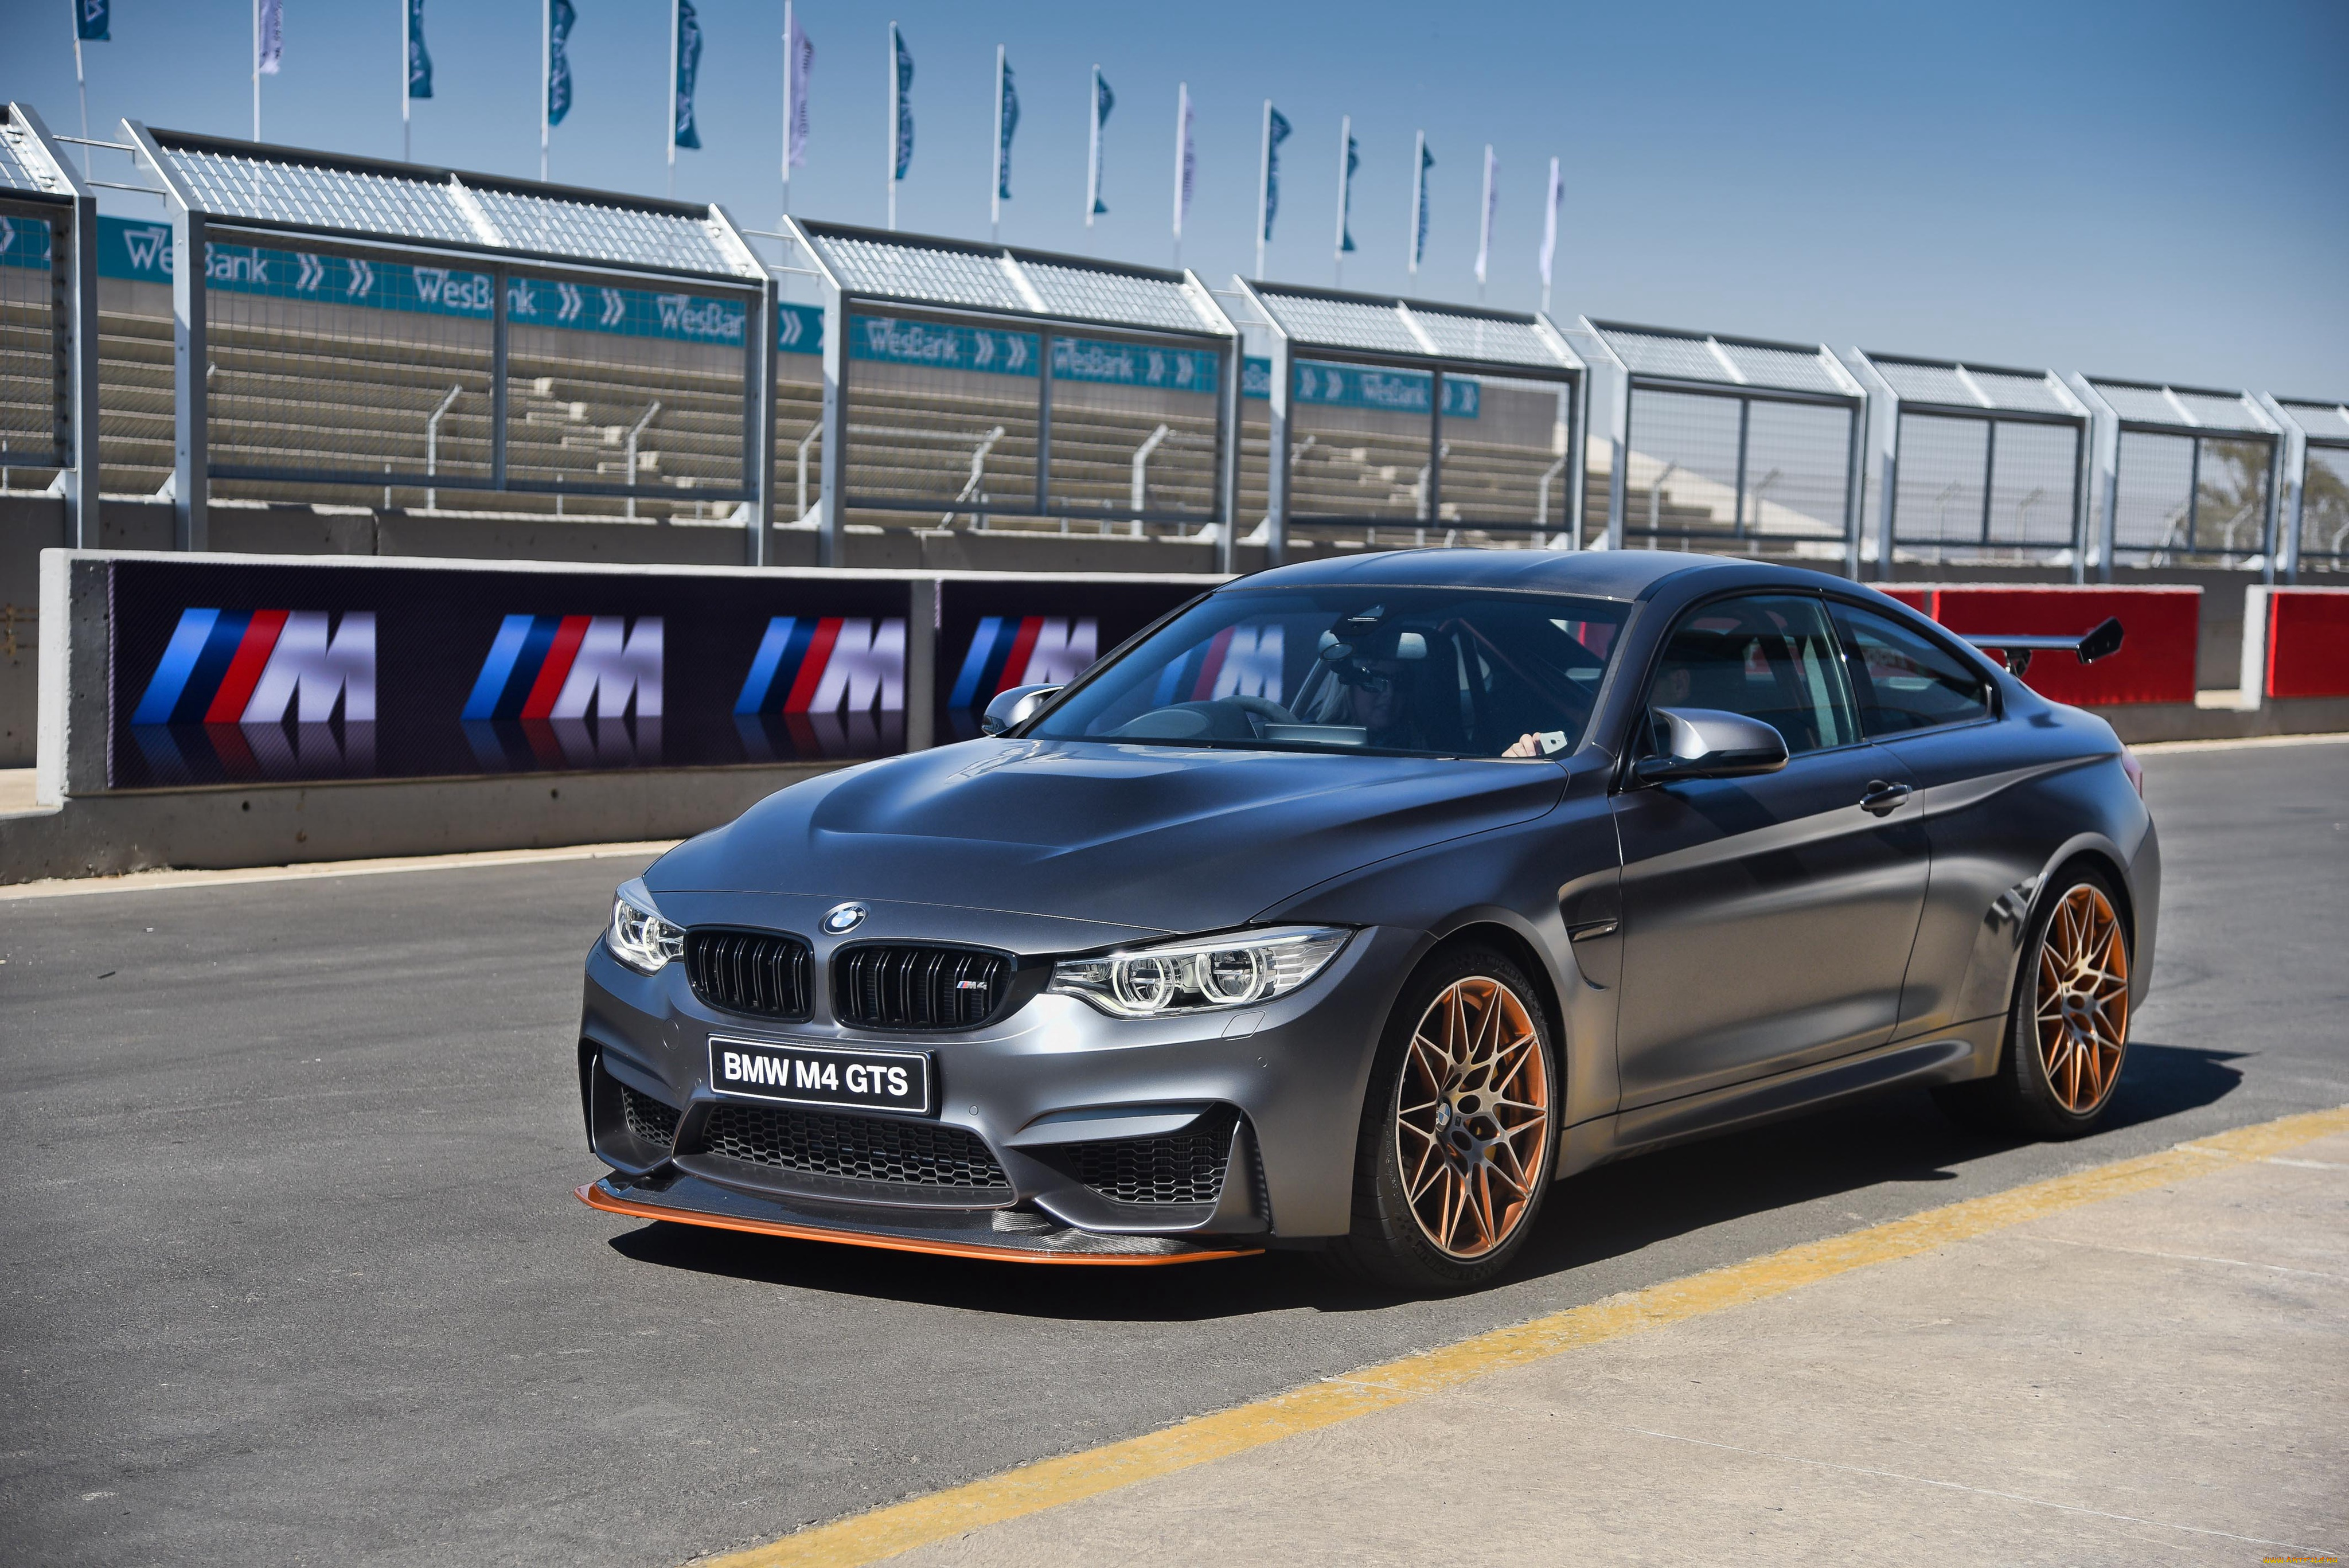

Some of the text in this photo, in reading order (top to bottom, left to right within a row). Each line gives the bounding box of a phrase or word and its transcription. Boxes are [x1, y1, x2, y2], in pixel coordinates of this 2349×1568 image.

[123, 226, 268, 284] WeBank
[413, 266, 537, 316] WesBnk
[867, 318, 959, 362] WesBank
[1053, 338, 1134, 379] WesBank
[724, 1052, 908, 1096] BMW M4 GTS
